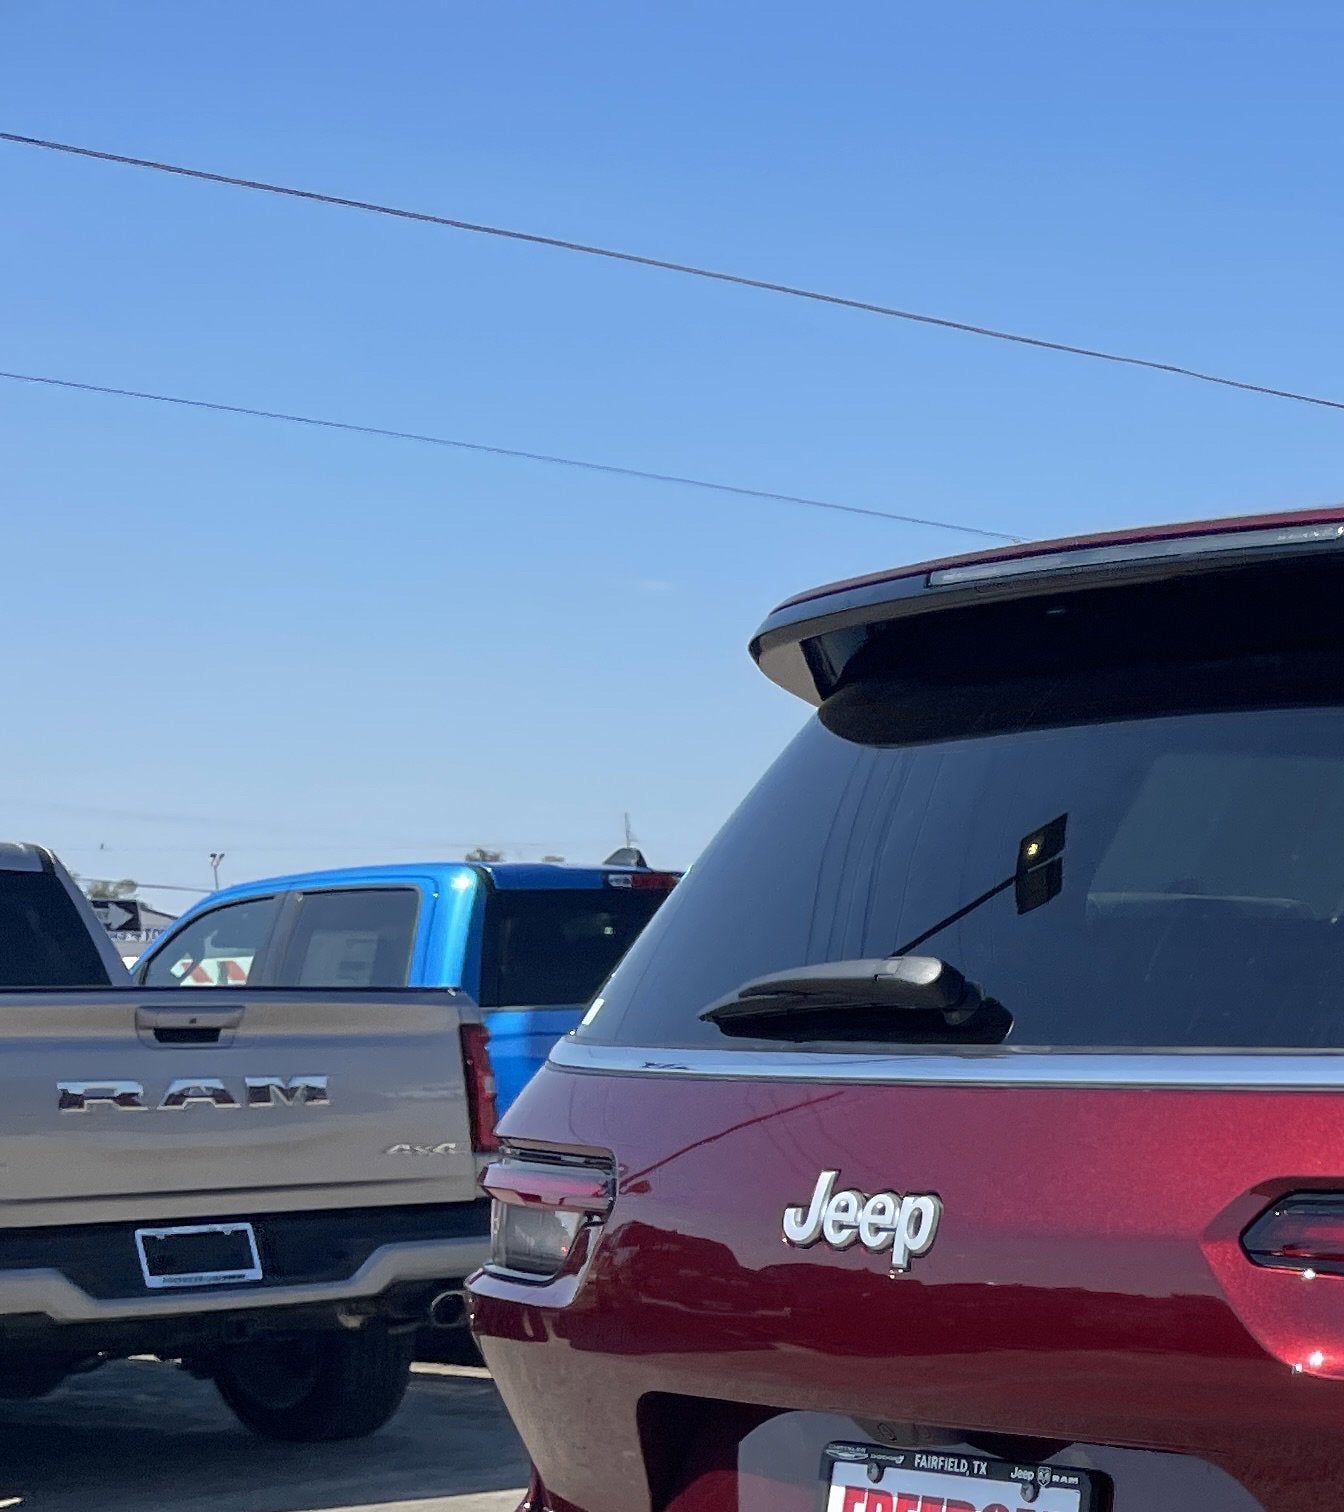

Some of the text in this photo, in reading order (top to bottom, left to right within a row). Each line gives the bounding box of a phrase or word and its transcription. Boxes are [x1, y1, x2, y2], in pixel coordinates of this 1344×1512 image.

[57, 1076, 331, 1113] RAM
[782, 1168, 943, 1270] Jeep
[914, 1454, 970, 1476] FAIRFIELD,
[972, 1460, 988, 1476] TX
[1010, 1467, 1079, 1485] Jeep RAM
